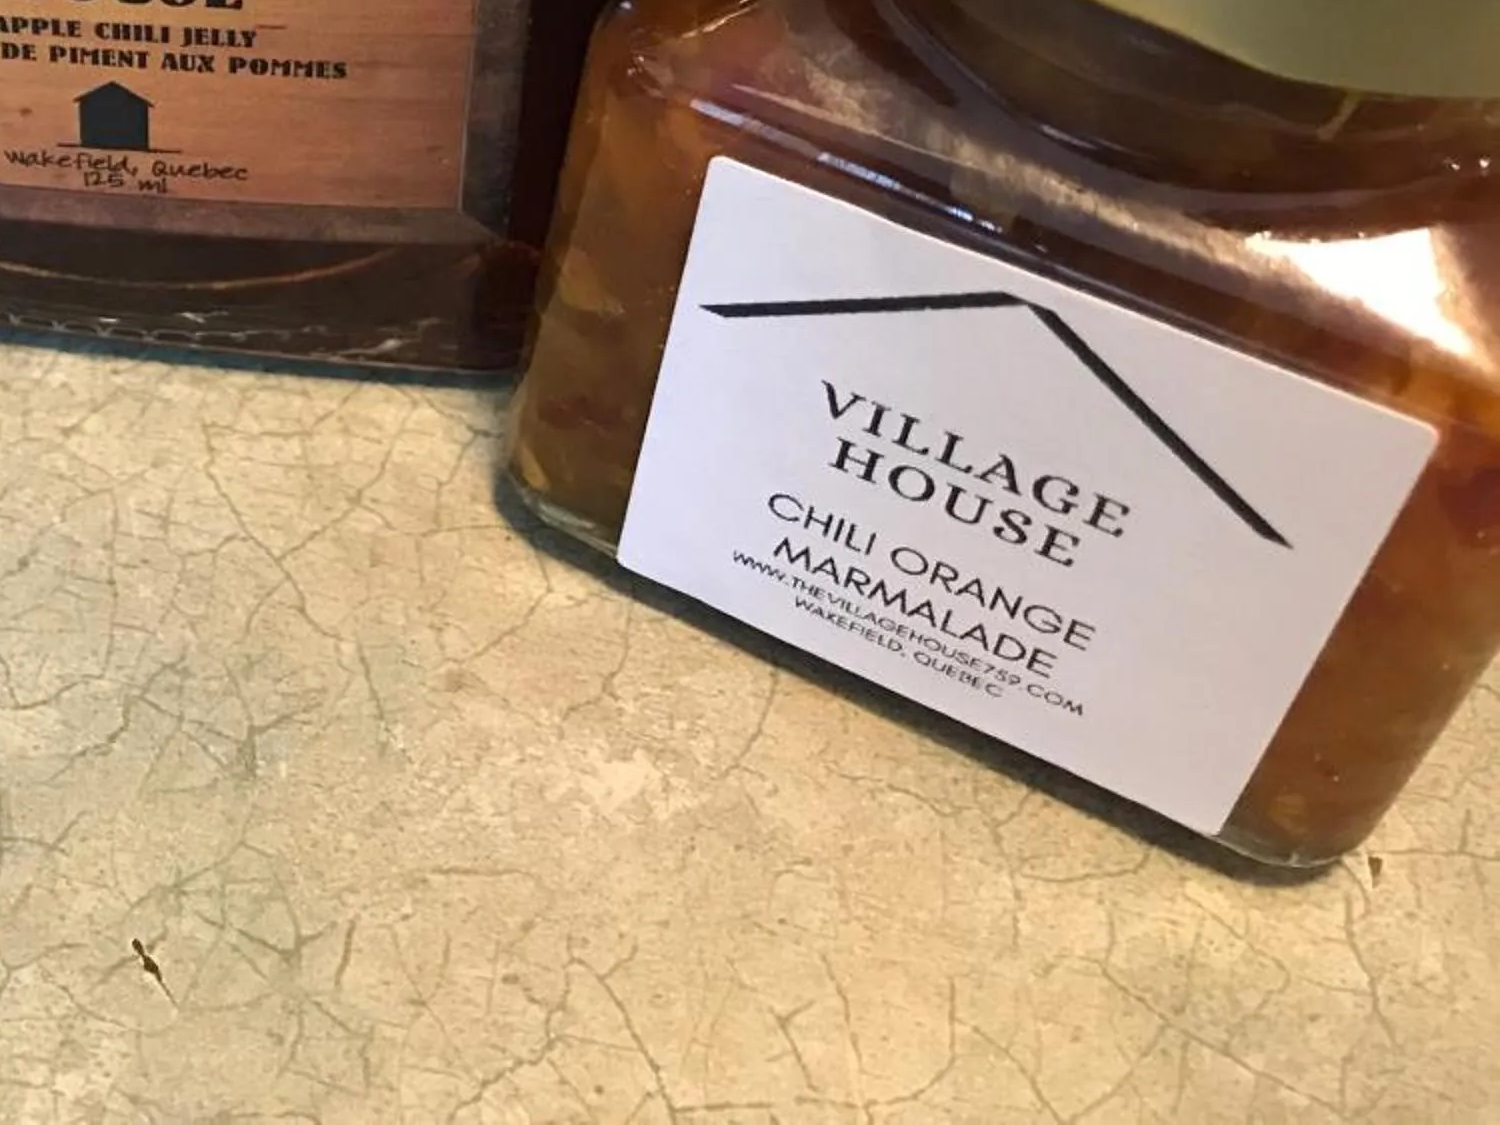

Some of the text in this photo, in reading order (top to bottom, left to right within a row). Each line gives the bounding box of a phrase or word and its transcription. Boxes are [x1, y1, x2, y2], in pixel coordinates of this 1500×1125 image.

[94, 22, 170, 45] CHILI
[180, 28, 257, 49] JELLY
[1, 42, 37, 63] DE
[49, 47, 150, 70] PIMENT
[161, 53, 216, 72] AUX
[228, 57, 348, 80] POMMES
[82, 171, 168, 194] 125 ml
[152, 160, 249, 181] Quebec
[820, 379, 1131, 538] VILLAGE
[828, 437, 1081, 567] HOUSE
[767, 493, 1096, 651] CHILI ORANGE
[772, 536, 1059, 679] MARMALADE
[913, 651, 1004, 697] QUEBEC
